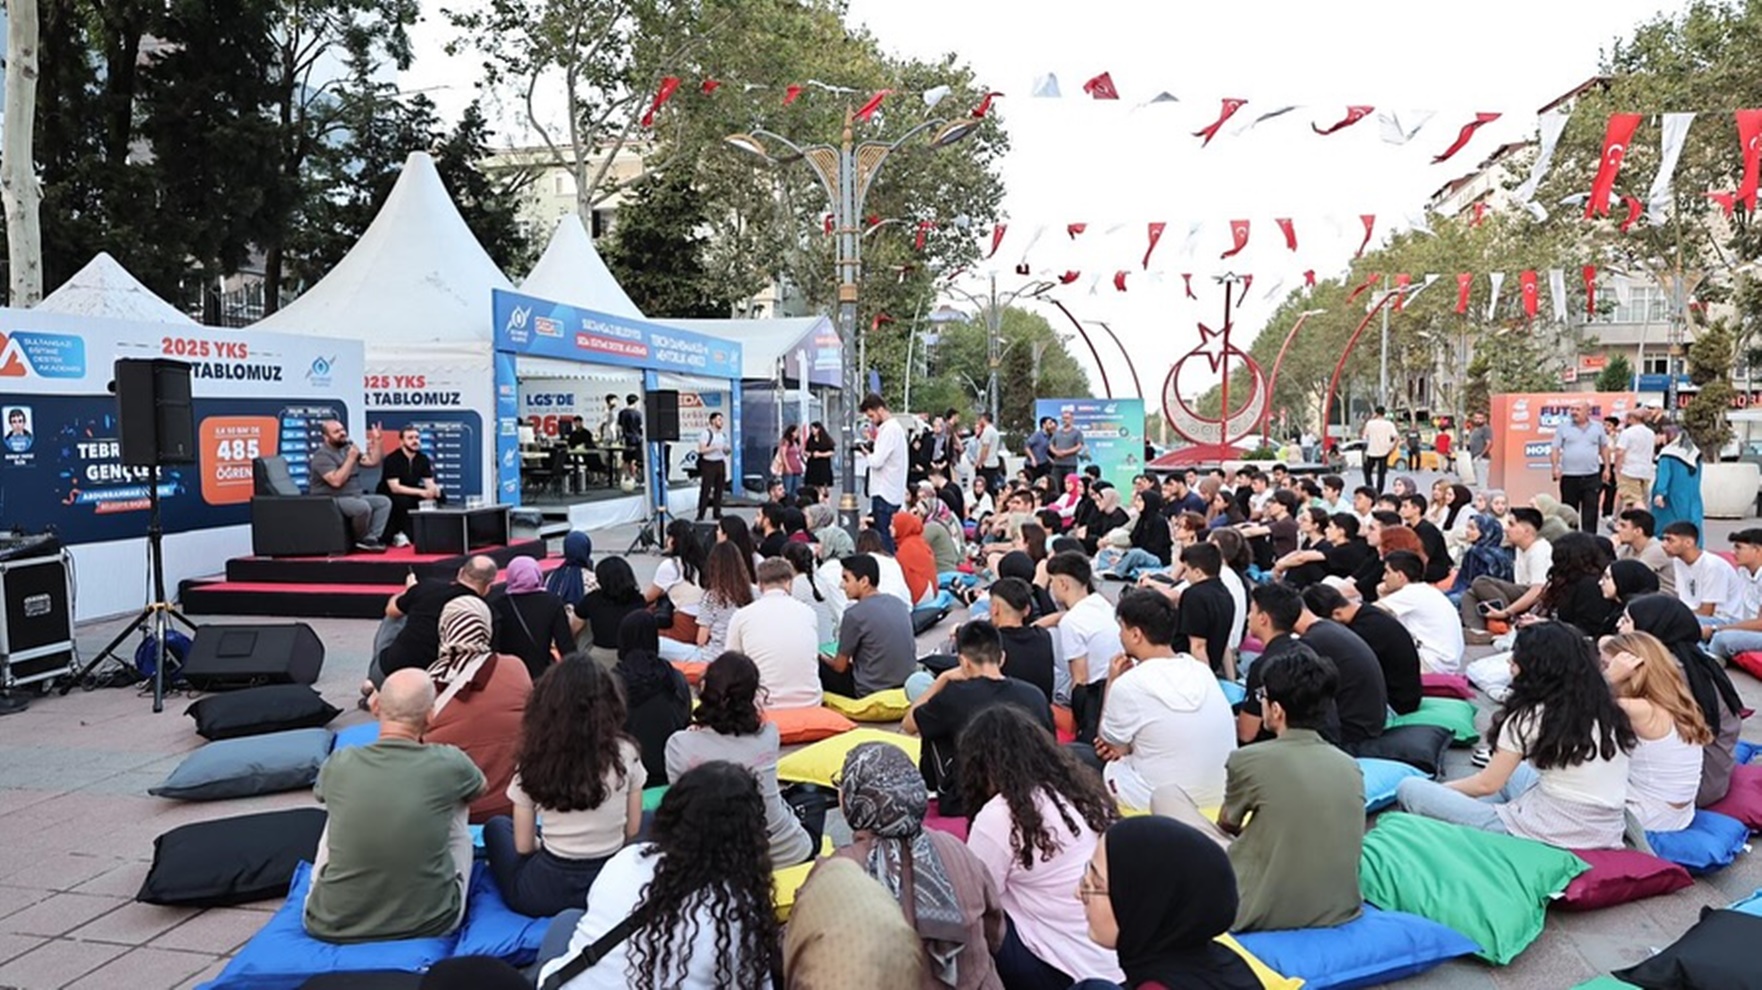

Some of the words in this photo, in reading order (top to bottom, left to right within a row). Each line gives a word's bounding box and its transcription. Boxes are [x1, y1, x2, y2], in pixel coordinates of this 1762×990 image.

[162, 337, 210, 357] 2025
[214, 341, 248, 359] YKS
[192, 362, 283, 381] TABLOMUZ
[394, 376, 426, 389] YKS
[373, 392, 461, 405] TABLOMUZ
[216, 440, 260, 460] 485
